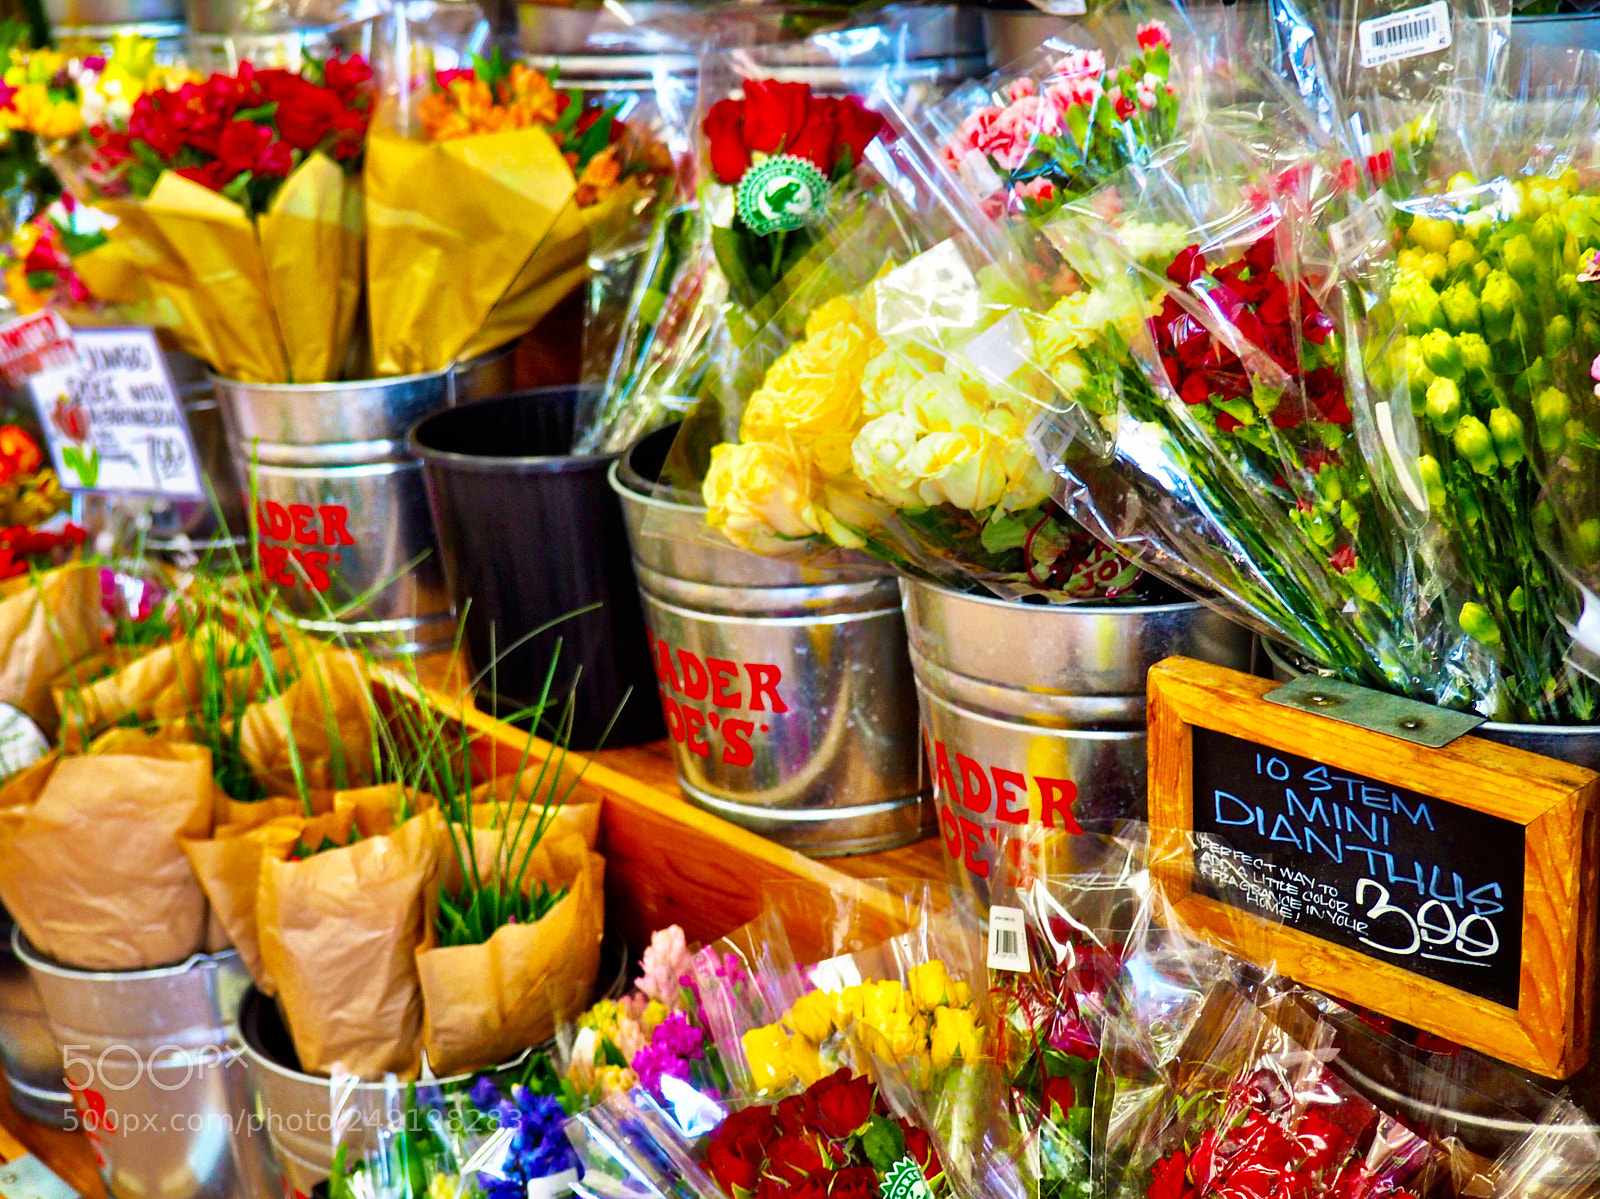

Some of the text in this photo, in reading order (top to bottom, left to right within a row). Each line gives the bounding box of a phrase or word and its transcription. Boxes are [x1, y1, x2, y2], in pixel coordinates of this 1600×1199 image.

[648, 630, 788, 713] ADER
[663, 690, 755, 767] OE'S
[925, 726, 1084, 835] ADER
[1256, 753, 1435, 831] 10 STEM
[1286, 788, 1389, 846] MINI
[1201, 836, 1339, 897] PERFECT WAY TO
[1214, 790, 1504, 916] DIANTHUS
[1212, 869, 1302, 910] FRAGRANCE
[1306, 905, 1325, 920] IN
[1326, 911, 1369, 936] YOUR
[1253, 873, 1299, 895] LITTLE
[1302, 891, 1350, 916] COLOR
